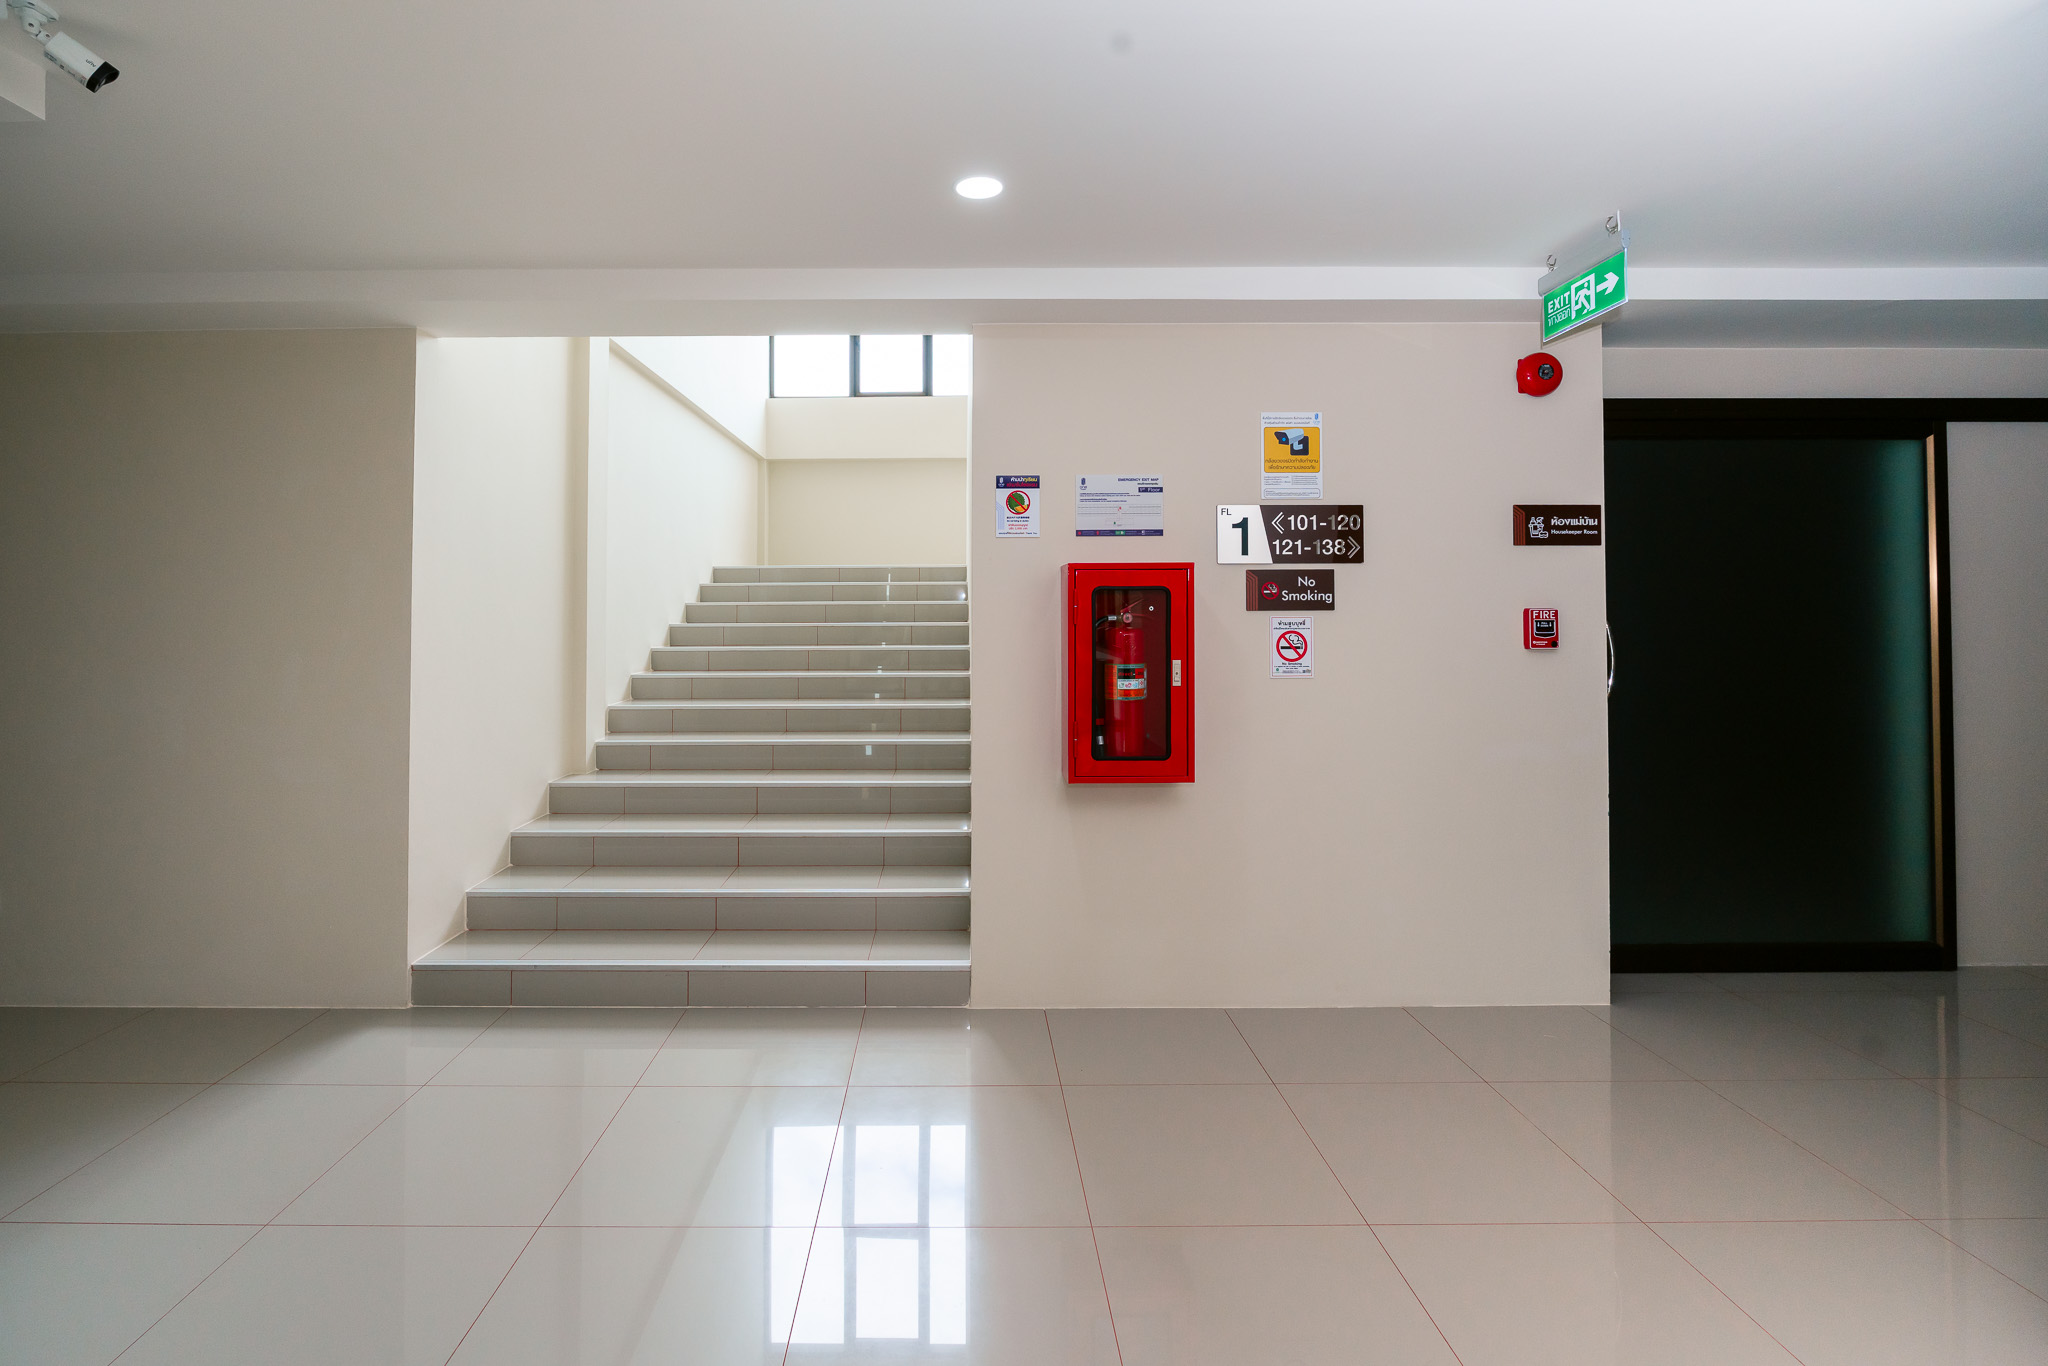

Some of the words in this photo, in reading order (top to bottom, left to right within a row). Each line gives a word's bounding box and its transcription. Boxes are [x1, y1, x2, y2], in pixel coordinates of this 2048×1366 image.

[1547, 291, 1571, 314] EXIT
[1547, 307, 1571, 327] ทางออก
[1220, 508, 1232, 516] FL
[1287, 514, 1361, 531] 101-120
[1551, 516, 1598, 526] ห้องแม่บ้าน
[1231, 517, 1248, 556] 1
[1272, 539, 1346, 555] 121-138
[1297, 576, 1316, 587] No
[1281, 590, 1333, 604] Smoking
[1533, 610, 1556, 619] FIRE
